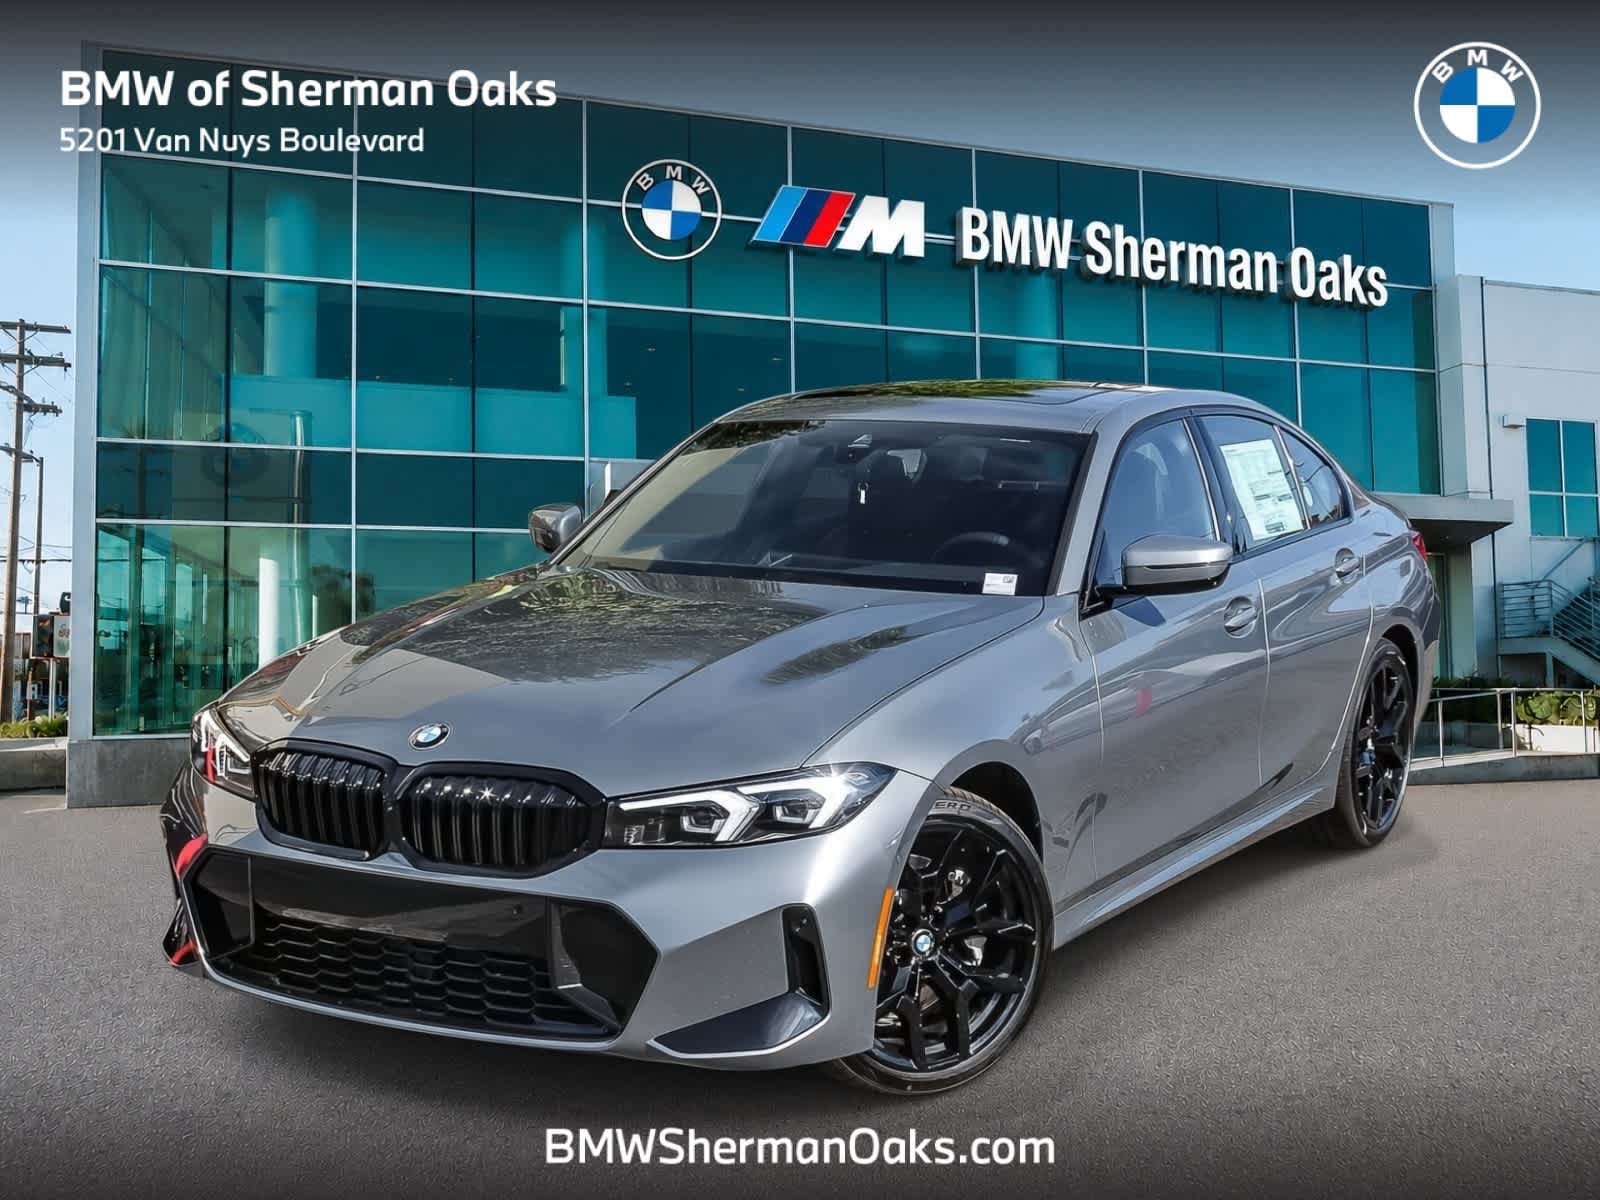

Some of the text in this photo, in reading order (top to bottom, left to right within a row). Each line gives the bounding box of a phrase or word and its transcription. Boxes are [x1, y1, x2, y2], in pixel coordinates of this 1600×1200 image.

[636, 165, 711, 195] BMW
[836, 195, 926, 258] M
[961, 206, 1389, 308] BMW Sherman Oaks
